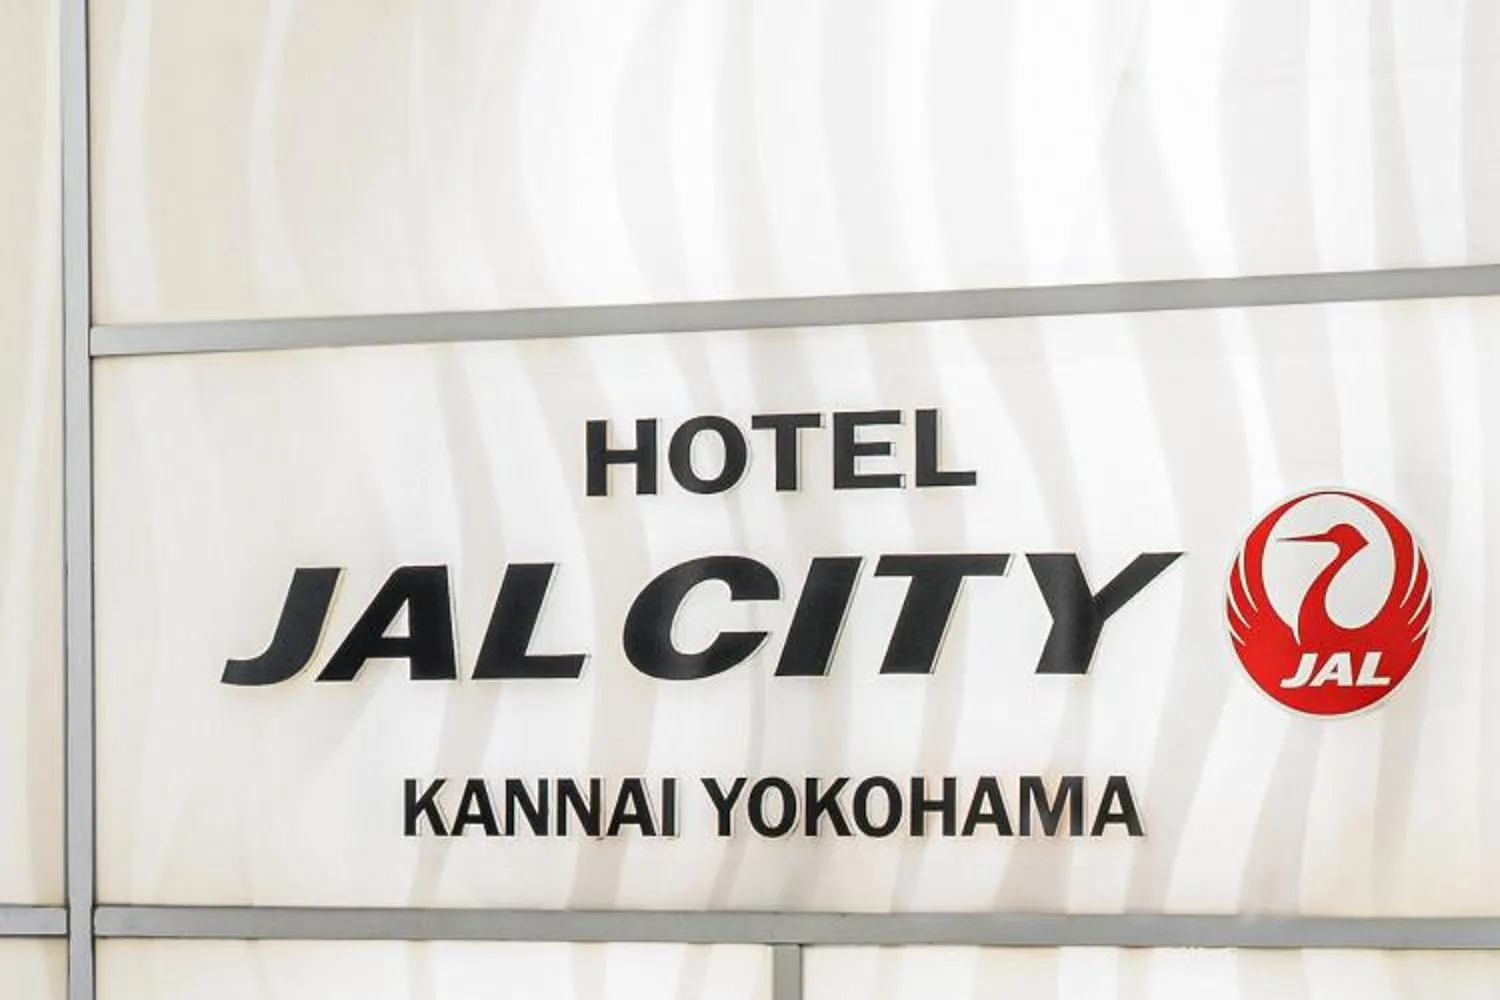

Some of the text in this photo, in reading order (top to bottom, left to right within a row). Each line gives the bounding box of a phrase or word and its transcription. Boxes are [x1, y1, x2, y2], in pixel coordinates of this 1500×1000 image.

[586, 409, 978, 497] HOTEL
[221, 552, 1183, 686] JAL CITY
[1279, 651, 1392, 689] JAL
[404, 776, 1144, 838] KANNAI YOKOHAMA
